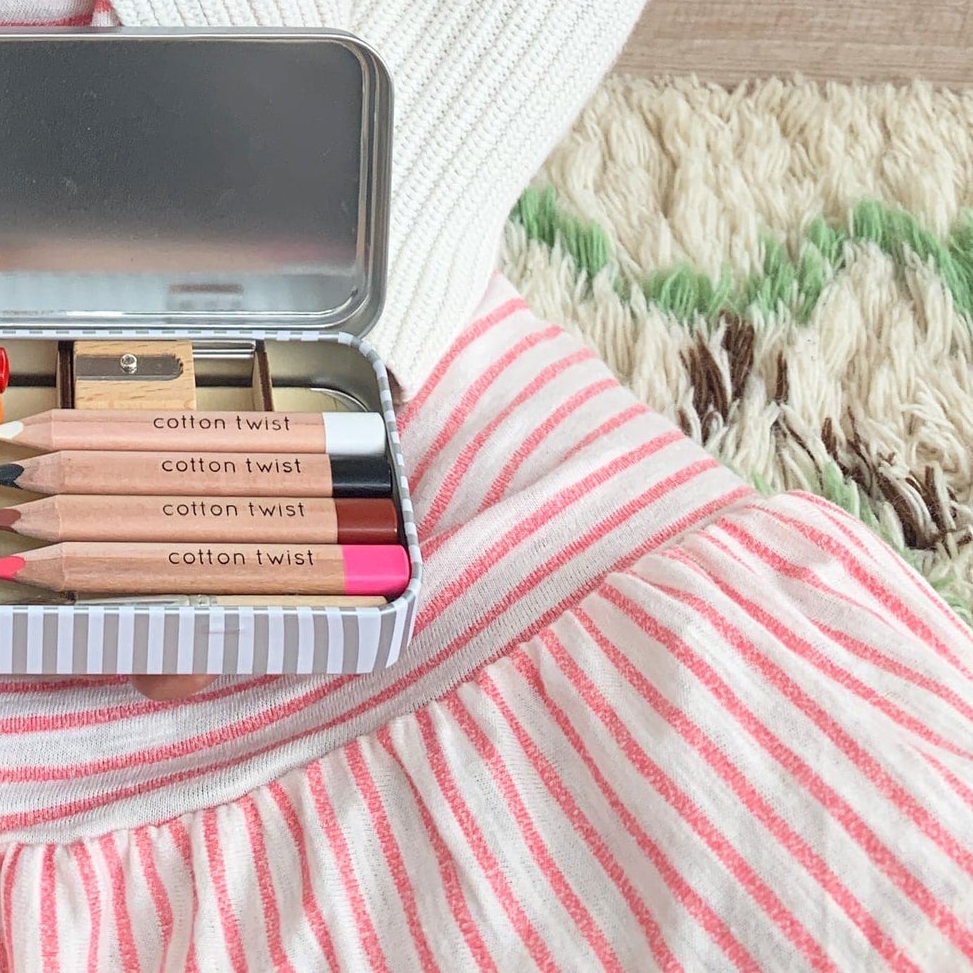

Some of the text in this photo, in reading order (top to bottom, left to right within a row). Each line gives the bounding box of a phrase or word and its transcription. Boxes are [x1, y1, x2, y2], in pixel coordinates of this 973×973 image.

[152, 414, 291, 431] cotton twist
[161, 457, 302, 474] cotton twist
[162, 500, 305, 518] cotton twist
[168, 548, 314, 567] cotton twist
